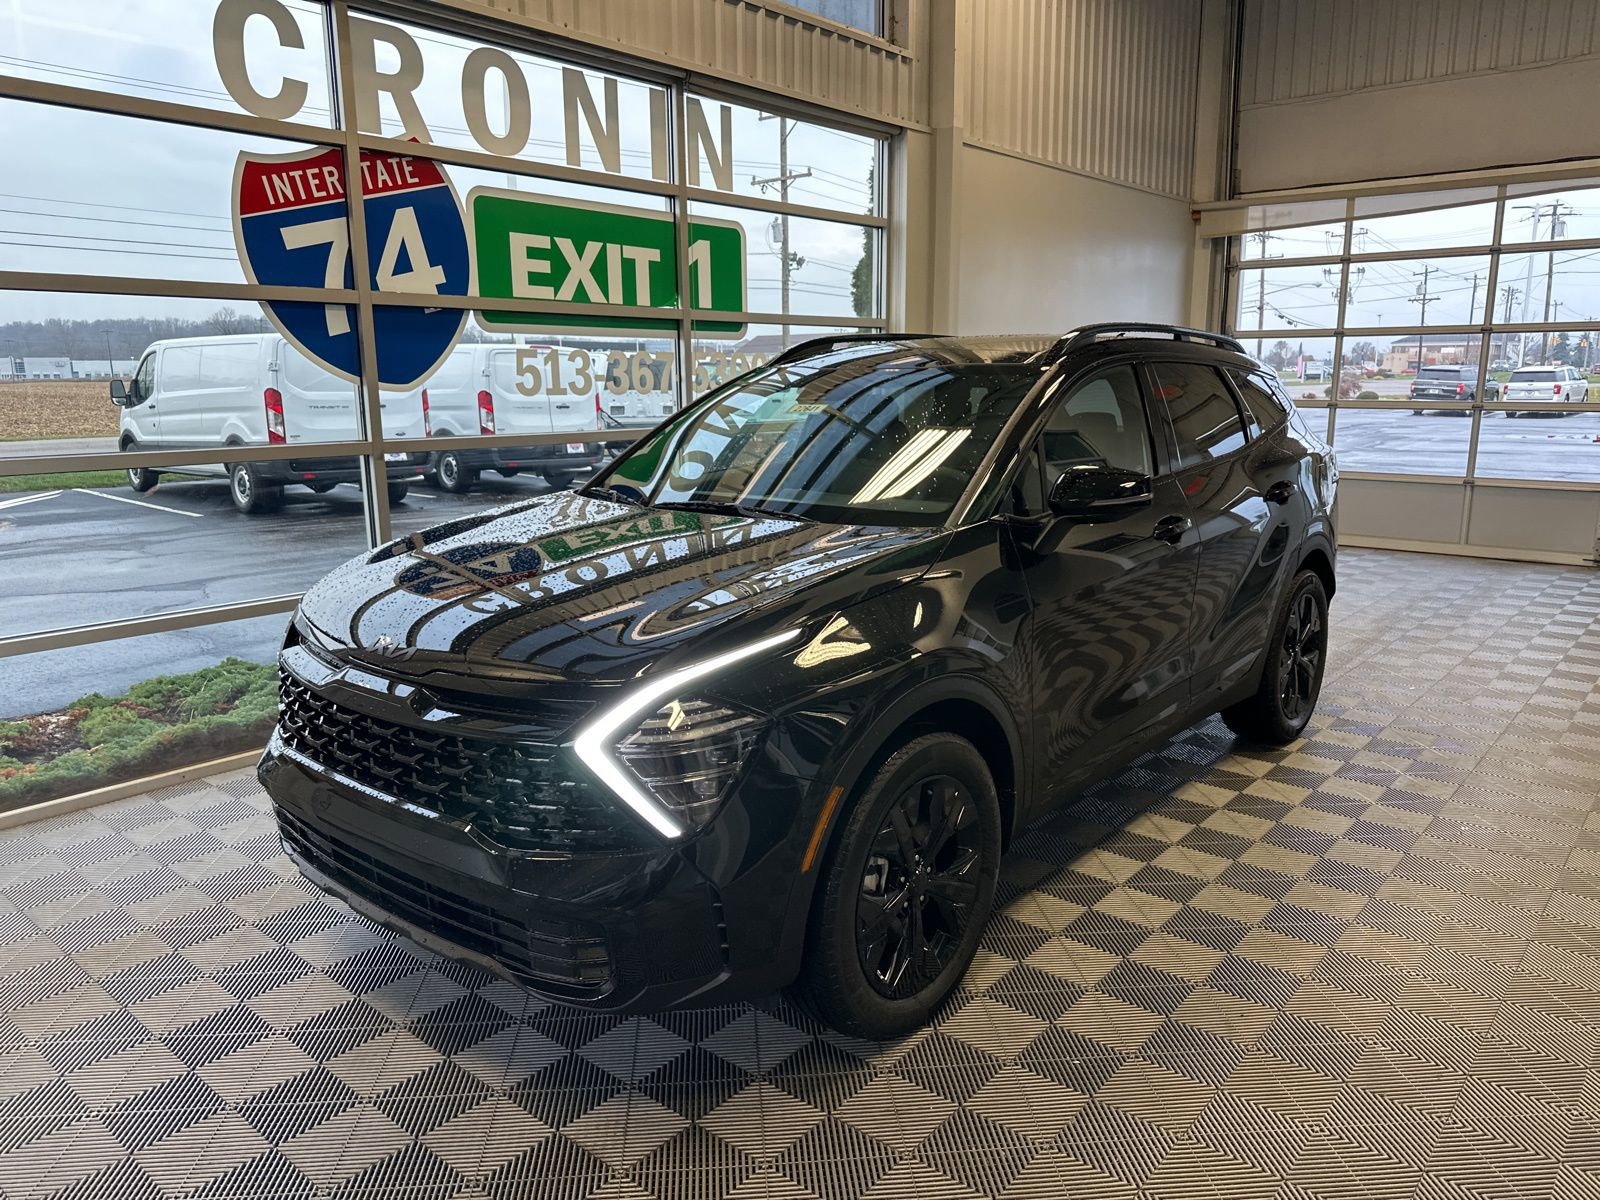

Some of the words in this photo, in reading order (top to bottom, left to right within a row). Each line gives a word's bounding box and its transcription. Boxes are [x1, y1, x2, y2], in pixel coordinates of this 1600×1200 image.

[213, 0, 733, 192] CRONIN
[261, 156, 419, 205] INTERTATE
[280, 206, 447, 337] 74
[509, 231, 661, 308] EXIT
[688, 239, 712, 309] 1
